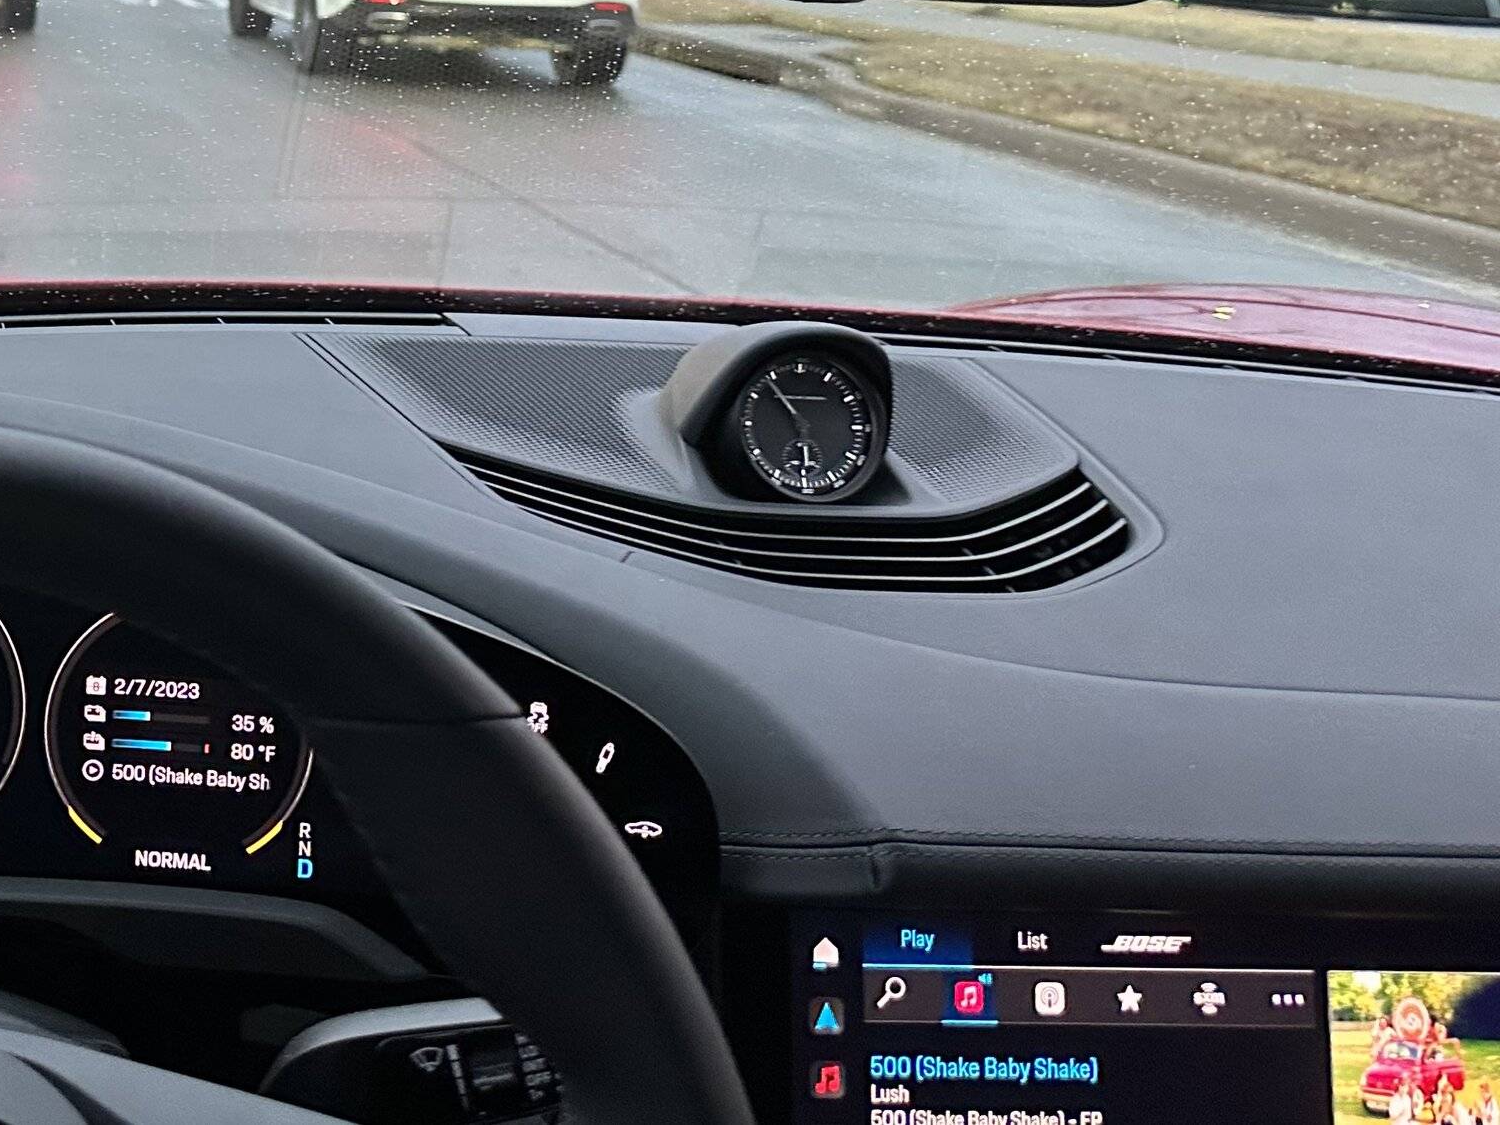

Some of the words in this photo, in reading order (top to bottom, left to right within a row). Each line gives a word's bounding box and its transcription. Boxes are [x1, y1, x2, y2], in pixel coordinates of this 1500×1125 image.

[114, 678, 200, 700] 2/7/2023
[231, 714, 255, 733] 35
[258, 715, 275, 734] %
[230, 742, 255, 761] 80
[257, 744, 276, 763] °F
[111, 763, 146, 782] 500
[148, 764, 204, 786] (Shake
[206, 769, 247, 793] Baby
[298, 821, 311, 839] R
[298, 840, 312, 857] N
[134, 849, 212, 872] NORMAL
[297, 858, 314, 879] D
[900, 929, 935, 952] Play
[1017, 930, 1048, 951] List
[1101, 934, 1192, 954] BOSE
[869, 1055, 912, 1078] 500
[915, 1054, 981, 1082] (Shake
[983, 1056, 1031, 1085] Baby
[1034, 1057, 1099, 1084] Shake)
[870, 1083, 910, 1104] Lush
[870, 1108, 907, 1125] 500
[908, 1108, 965, 1125] (Shake
[967, 1110, 1008, 1125] Baby
[1009, 1109, 1066, 1125] Shake)
